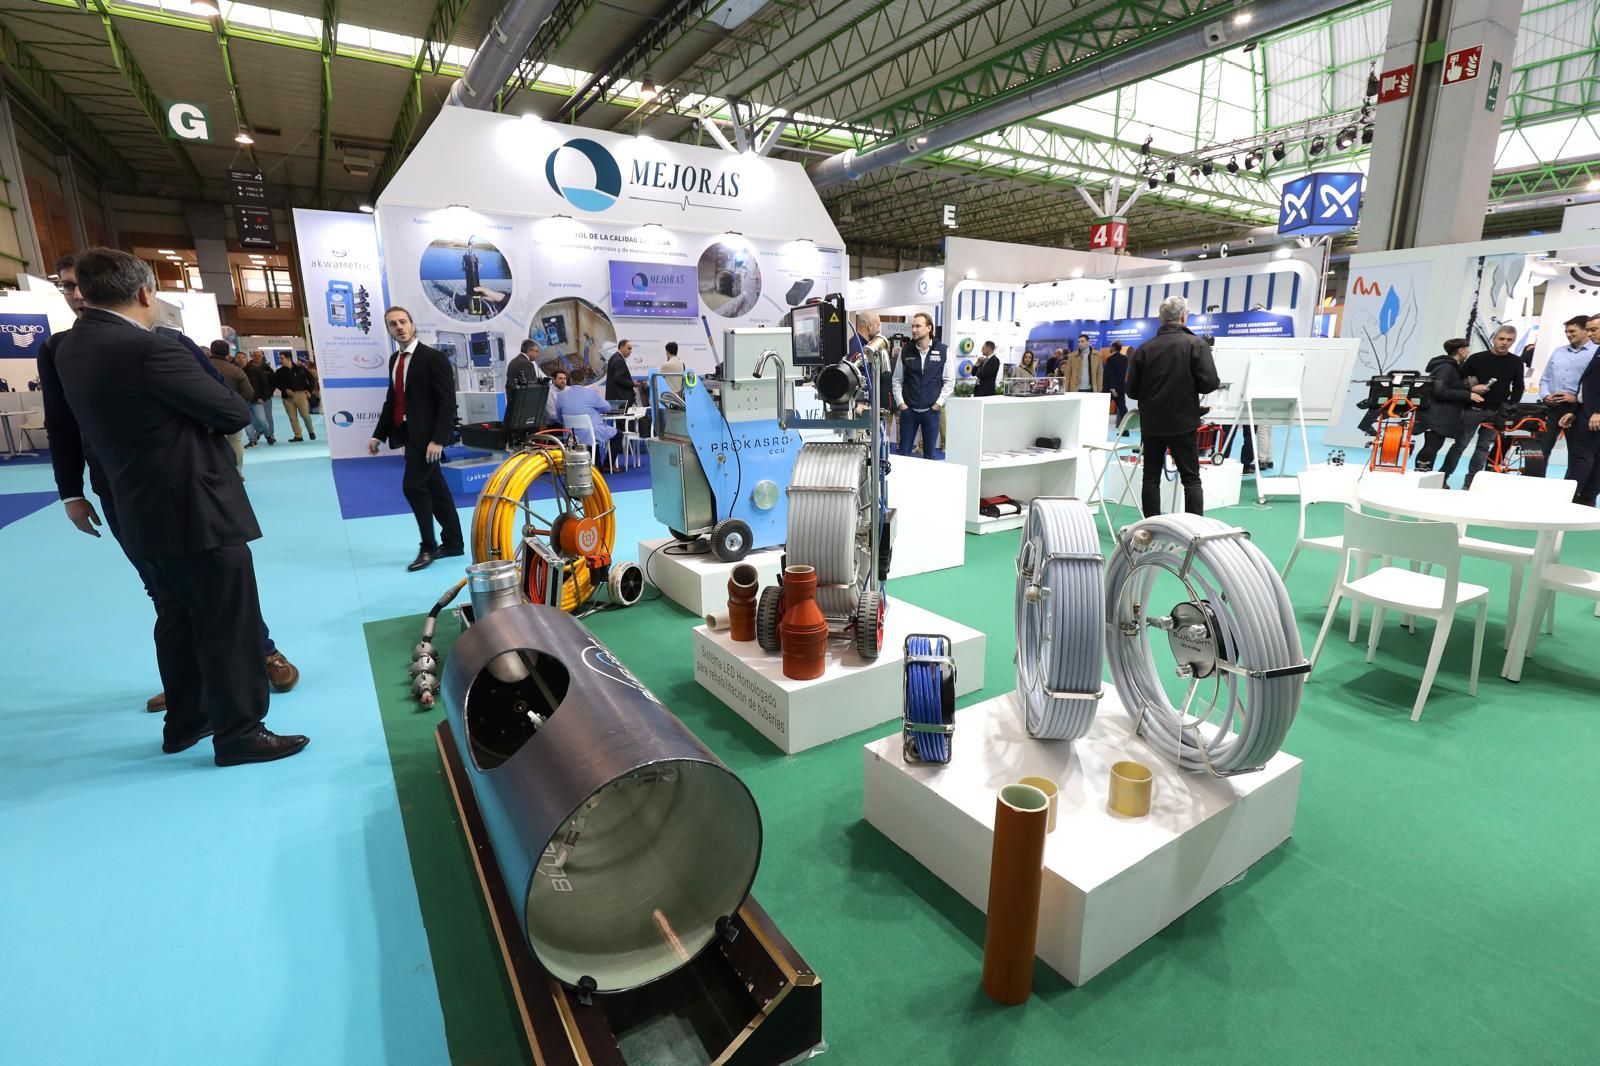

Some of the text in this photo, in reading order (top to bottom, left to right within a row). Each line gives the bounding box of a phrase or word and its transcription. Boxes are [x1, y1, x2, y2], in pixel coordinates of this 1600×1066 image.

[169, 103, 208, 140] G
[629, 159, 740, 197] MEJORAS
[944, 205, 956, 225] E
[609, 235, 638, 243] CALIDAD
[1094, 225, 1108, 246] 4
[1113, 225, 1124, 246] 4
[1221, 244, 1228, 258] C
[650, 275, 685, 284] MEJORAS
[711, 436, 789, 452] PROKASRO
[701, 645, 777, 708] Sistema LED Homologado
[697, 660, 785, 734] para rehabilitación de tuberías
